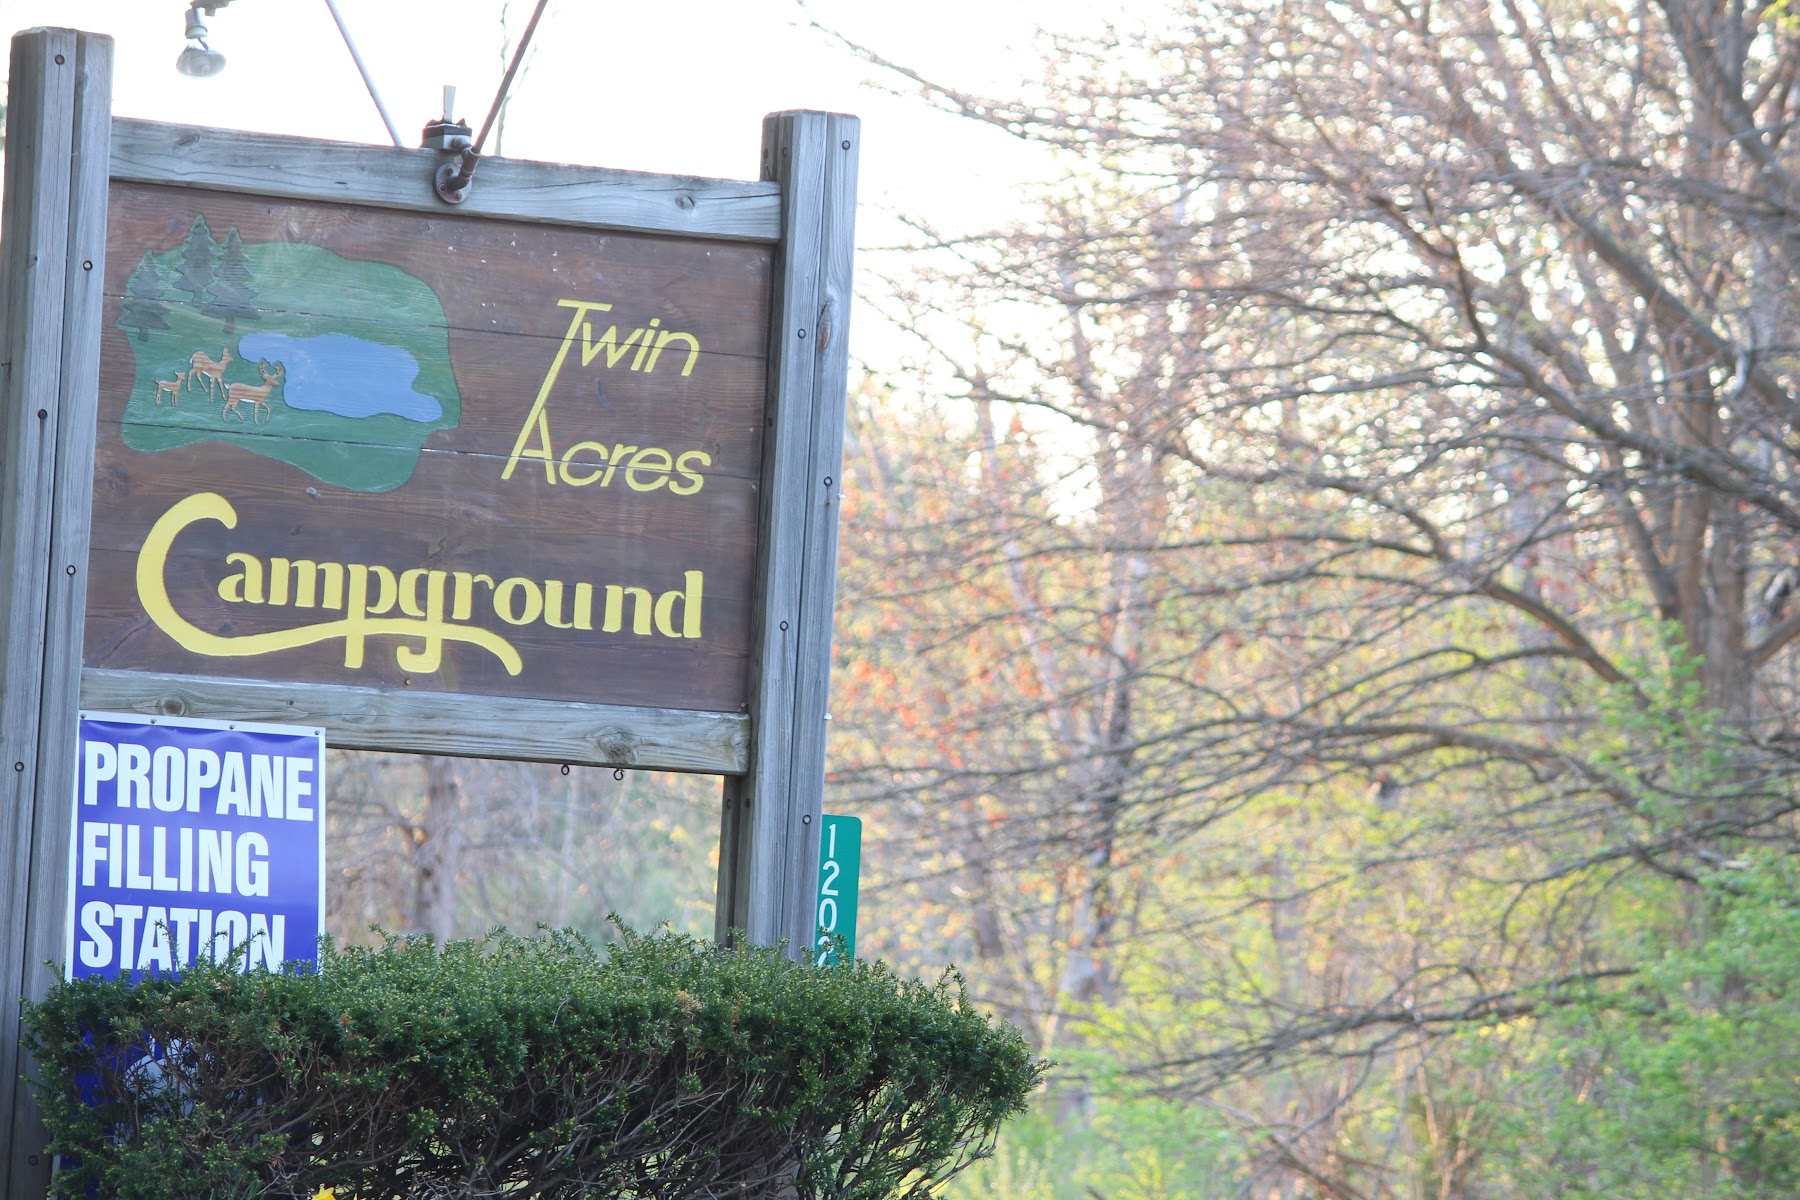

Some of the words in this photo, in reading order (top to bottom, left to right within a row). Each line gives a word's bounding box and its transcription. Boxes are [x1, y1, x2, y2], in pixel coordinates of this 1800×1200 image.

[533, 299, 701, 402] Twin
[501, 409, 714, 496] Acres
[136, 492, 704, 676] Campground
[83, 740, 314, 822] PROPANE
[81, 821, 270, 897] FILLING
[79, 900, 286, 976] STATION
